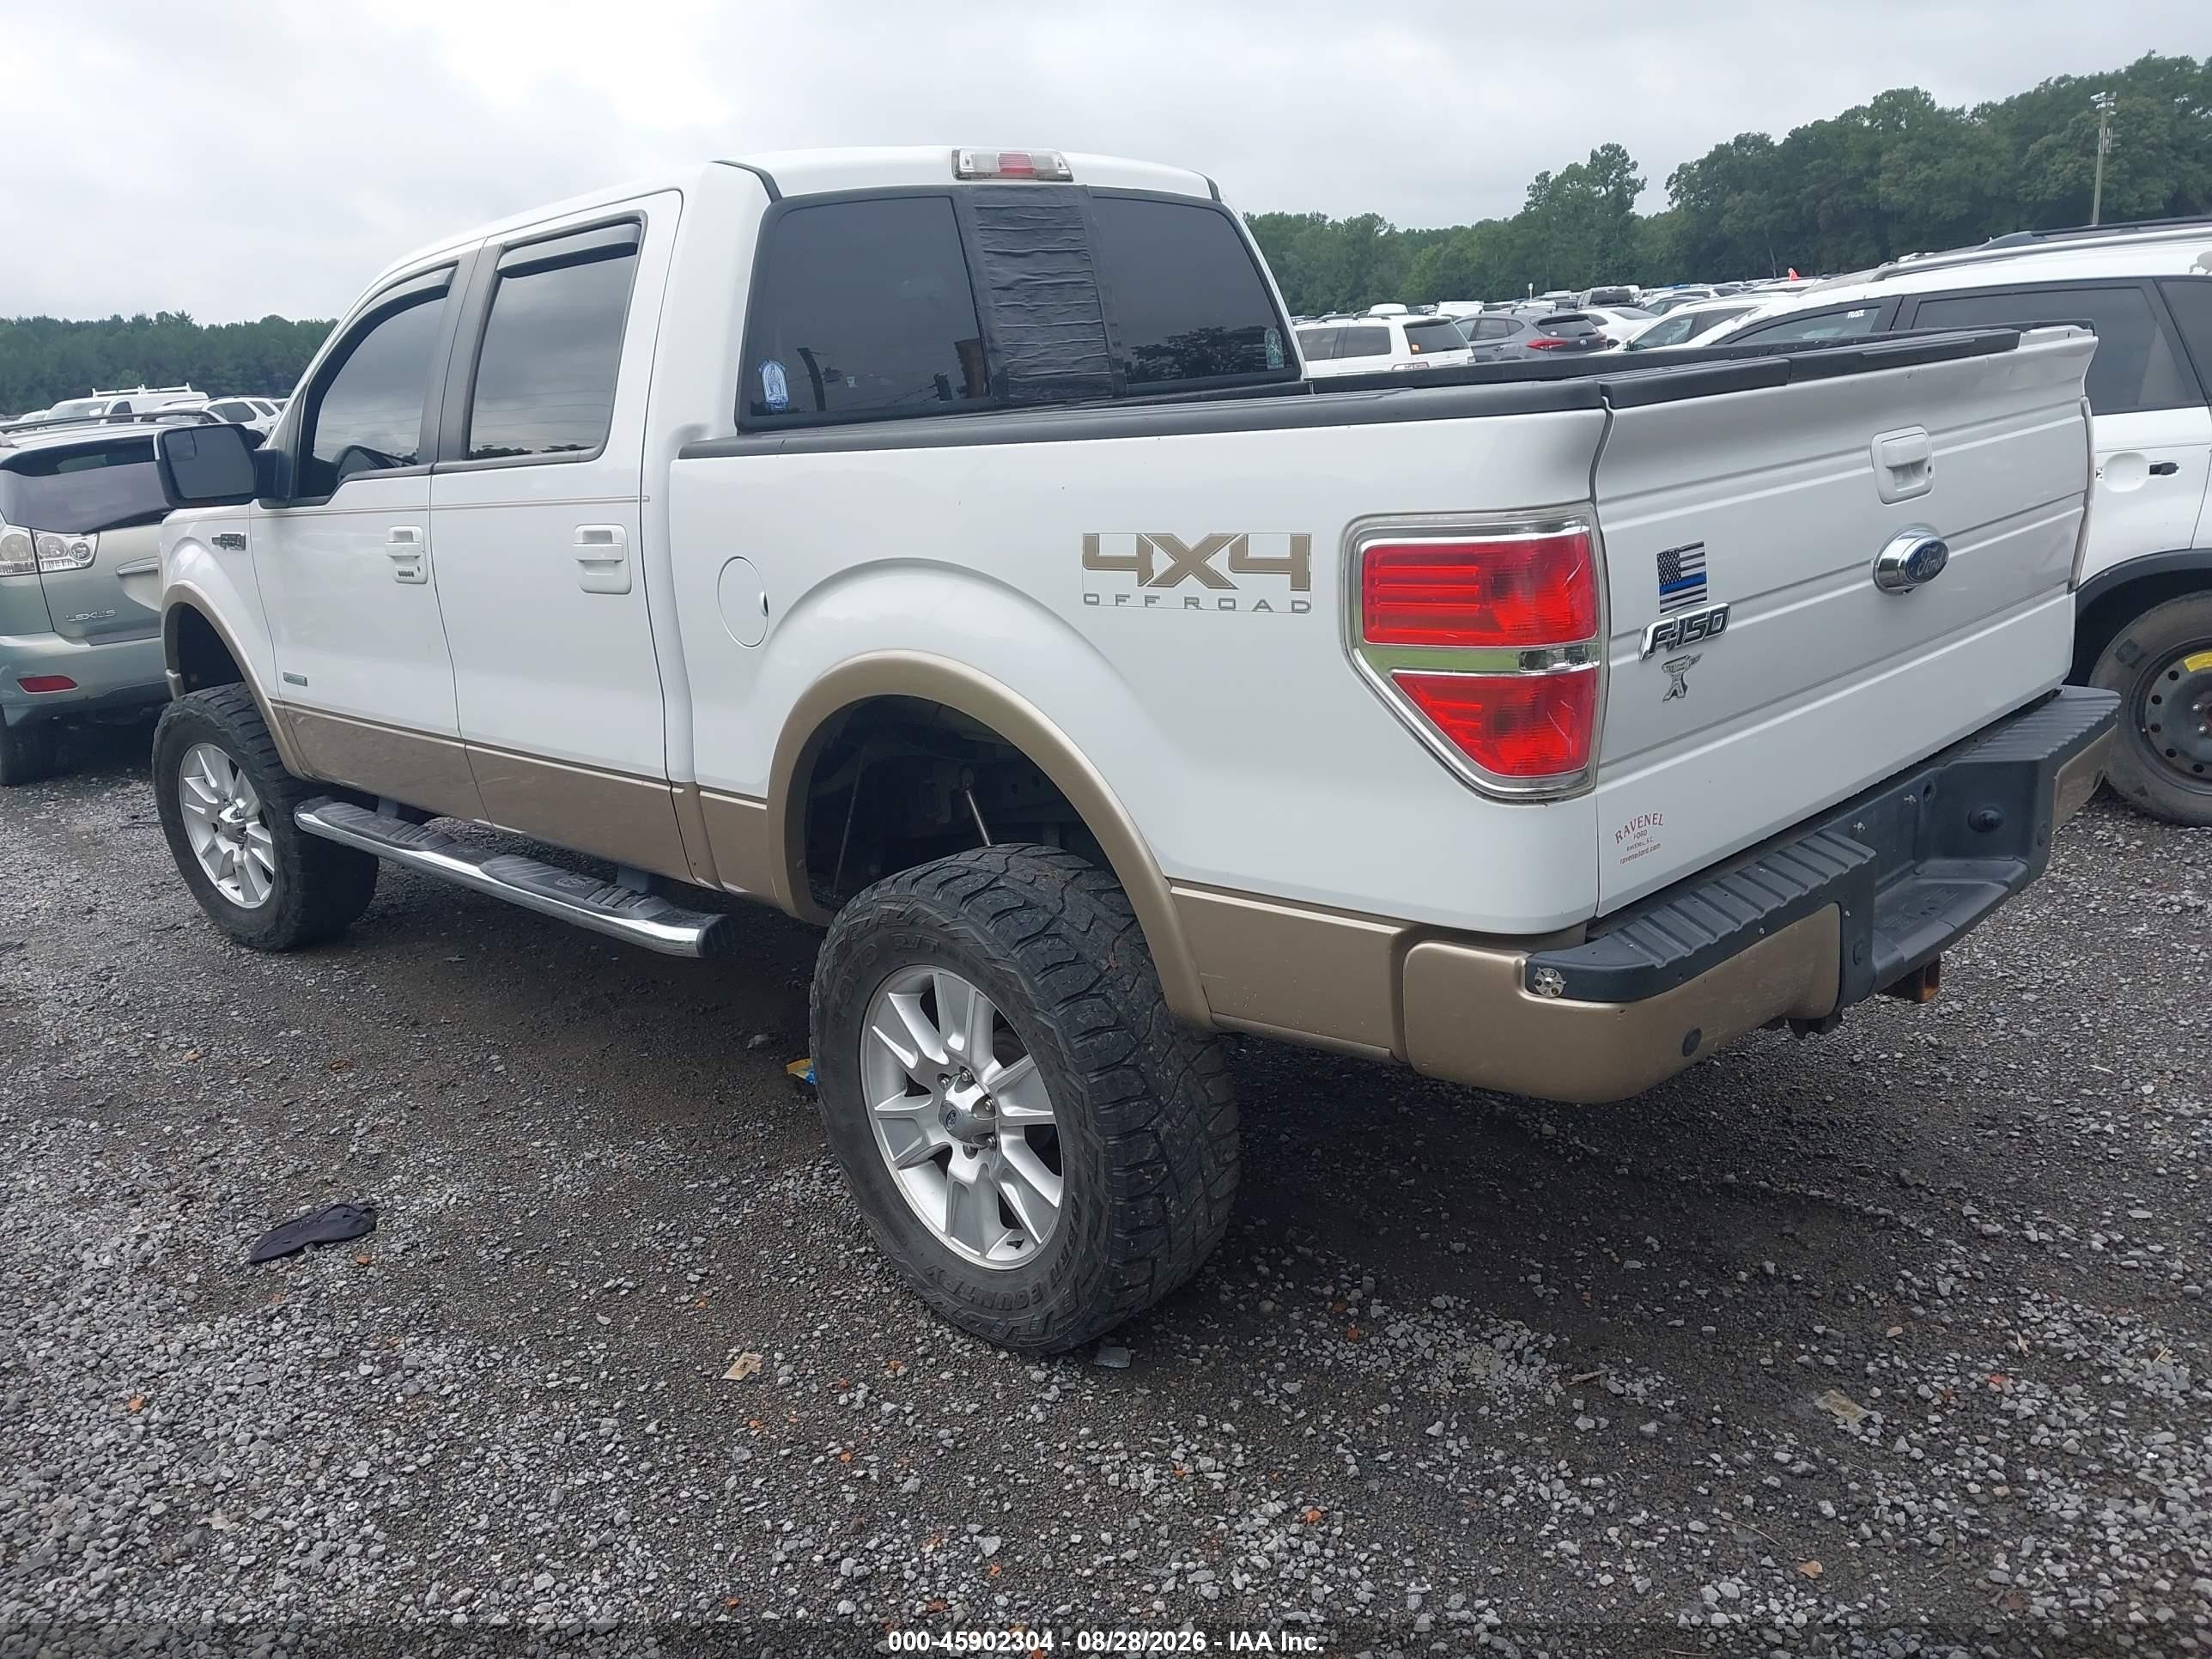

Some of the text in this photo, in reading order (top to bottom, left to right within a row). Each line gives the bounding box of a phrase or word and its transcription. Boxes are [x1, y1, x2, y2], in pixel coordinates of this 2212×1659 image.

[1082, 533, 1311, 592] 4X4
[65, 609, 117, 623] LEXUS
[1614, 812, 1663, 845] RAVENEL
[1633, 830, 1648, 841] FORD
